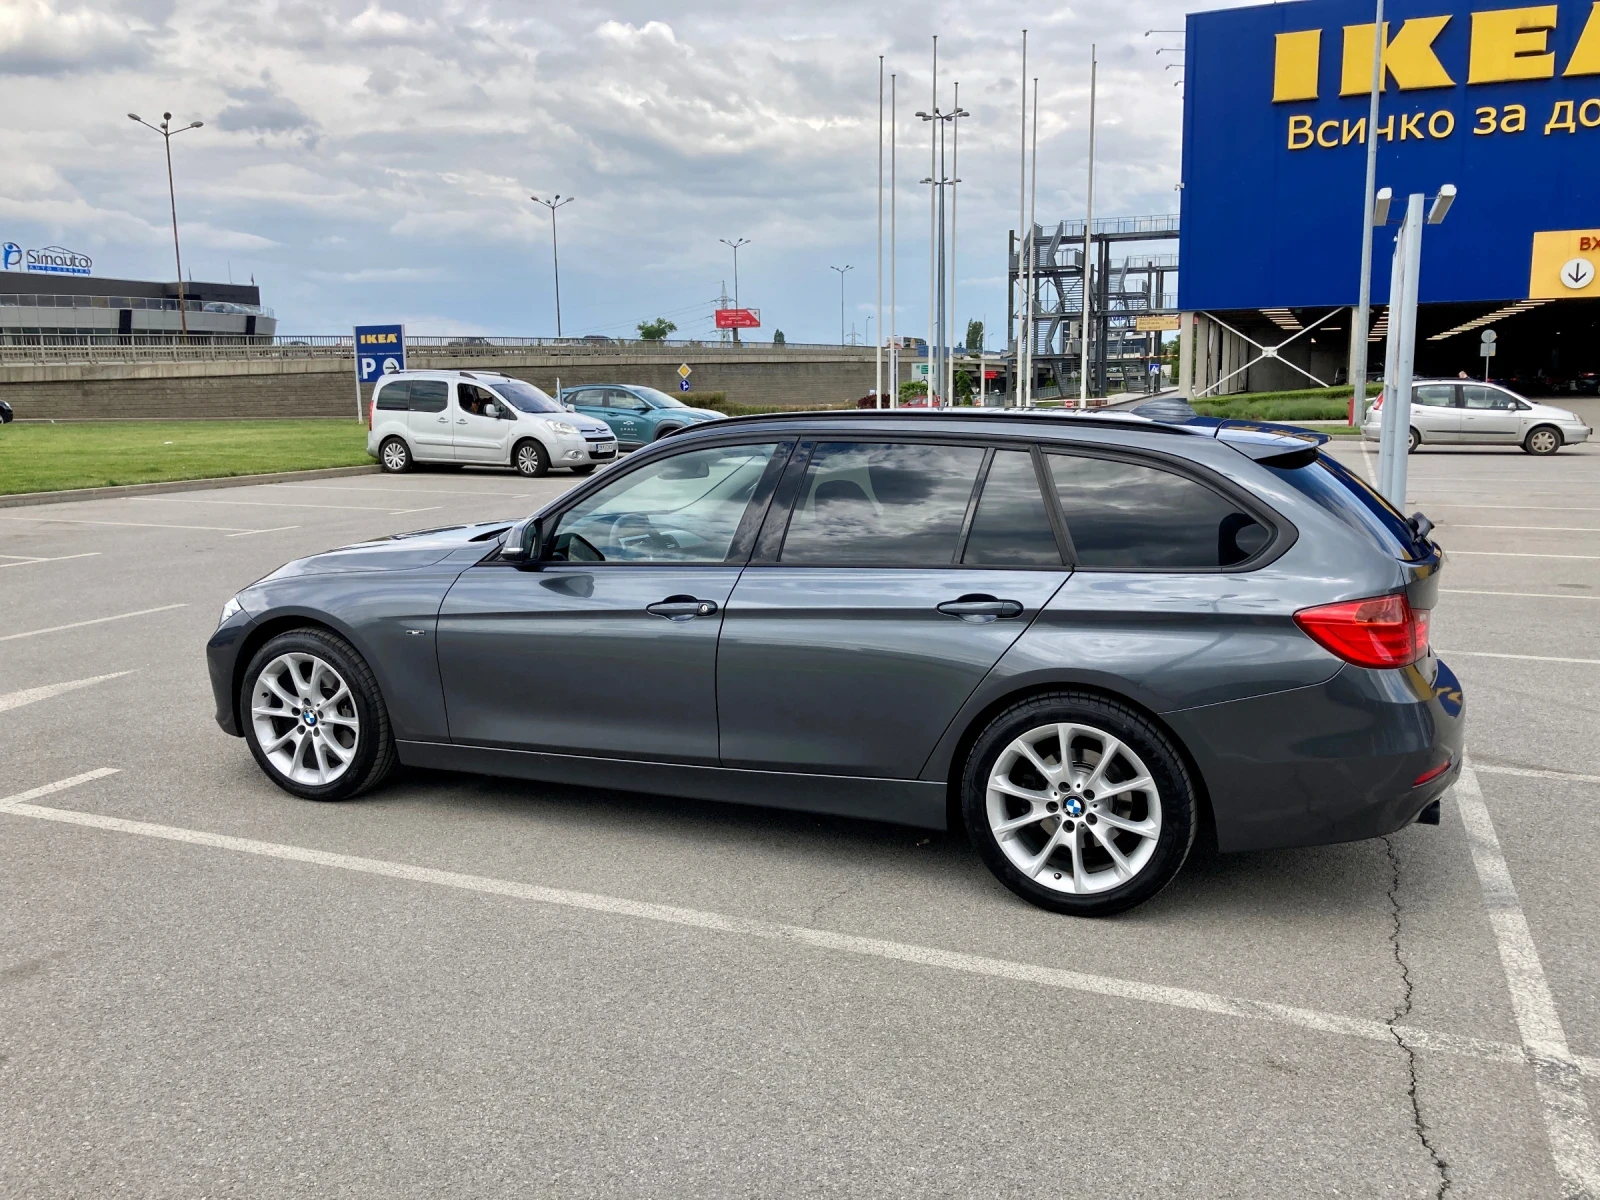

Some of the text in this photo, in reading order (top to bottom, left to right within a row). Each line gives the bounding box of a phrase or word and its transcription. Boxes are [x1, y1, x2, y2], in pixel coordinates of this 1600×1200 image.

[1287, 98, 1600, 149] Всичко за до
[27, 249, 89, 267] Simauto
[360, 334, 397, 343] IKEA
[362, 358, 376, 379] P
